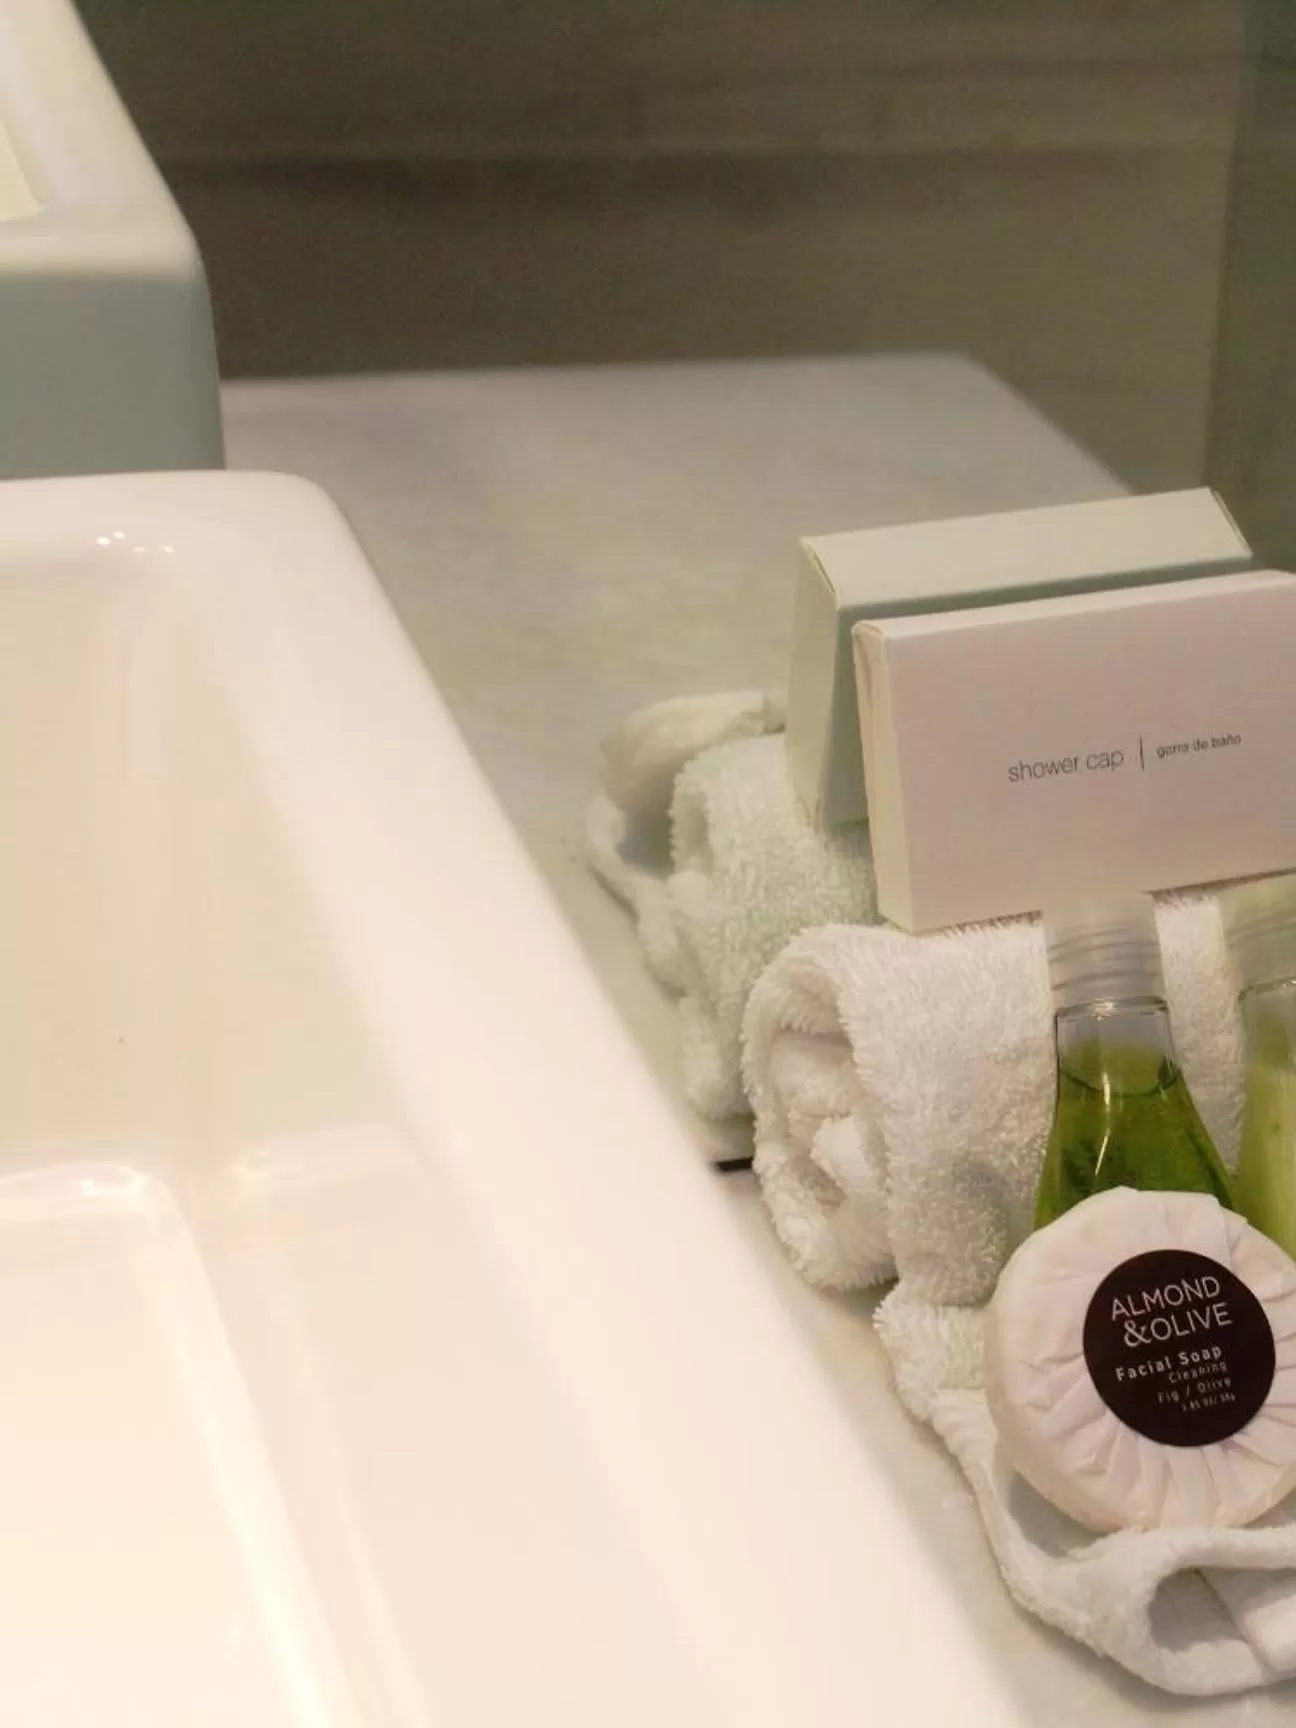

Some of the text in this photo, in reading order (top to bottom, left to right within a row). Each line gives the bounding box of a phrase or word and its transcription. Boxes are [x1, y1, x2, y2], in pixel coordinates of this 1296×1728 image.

[1008, 754, 1079, 783] shower
[1085, 749, 1125, 772] cap
[1192, 738, 1209, 752] de
[1211, 733, 1242, 749] baño
[1111, 1276, 1221, 1321] ALMOND
[1123, 1302, 1233, 1348] &OLIVE
[1115, 1346, 1222, 1382] Facial Soap
[1168, 1361, 1228, 1384] Cleaning
[1197, 1377, 1232, 1393] Olive
